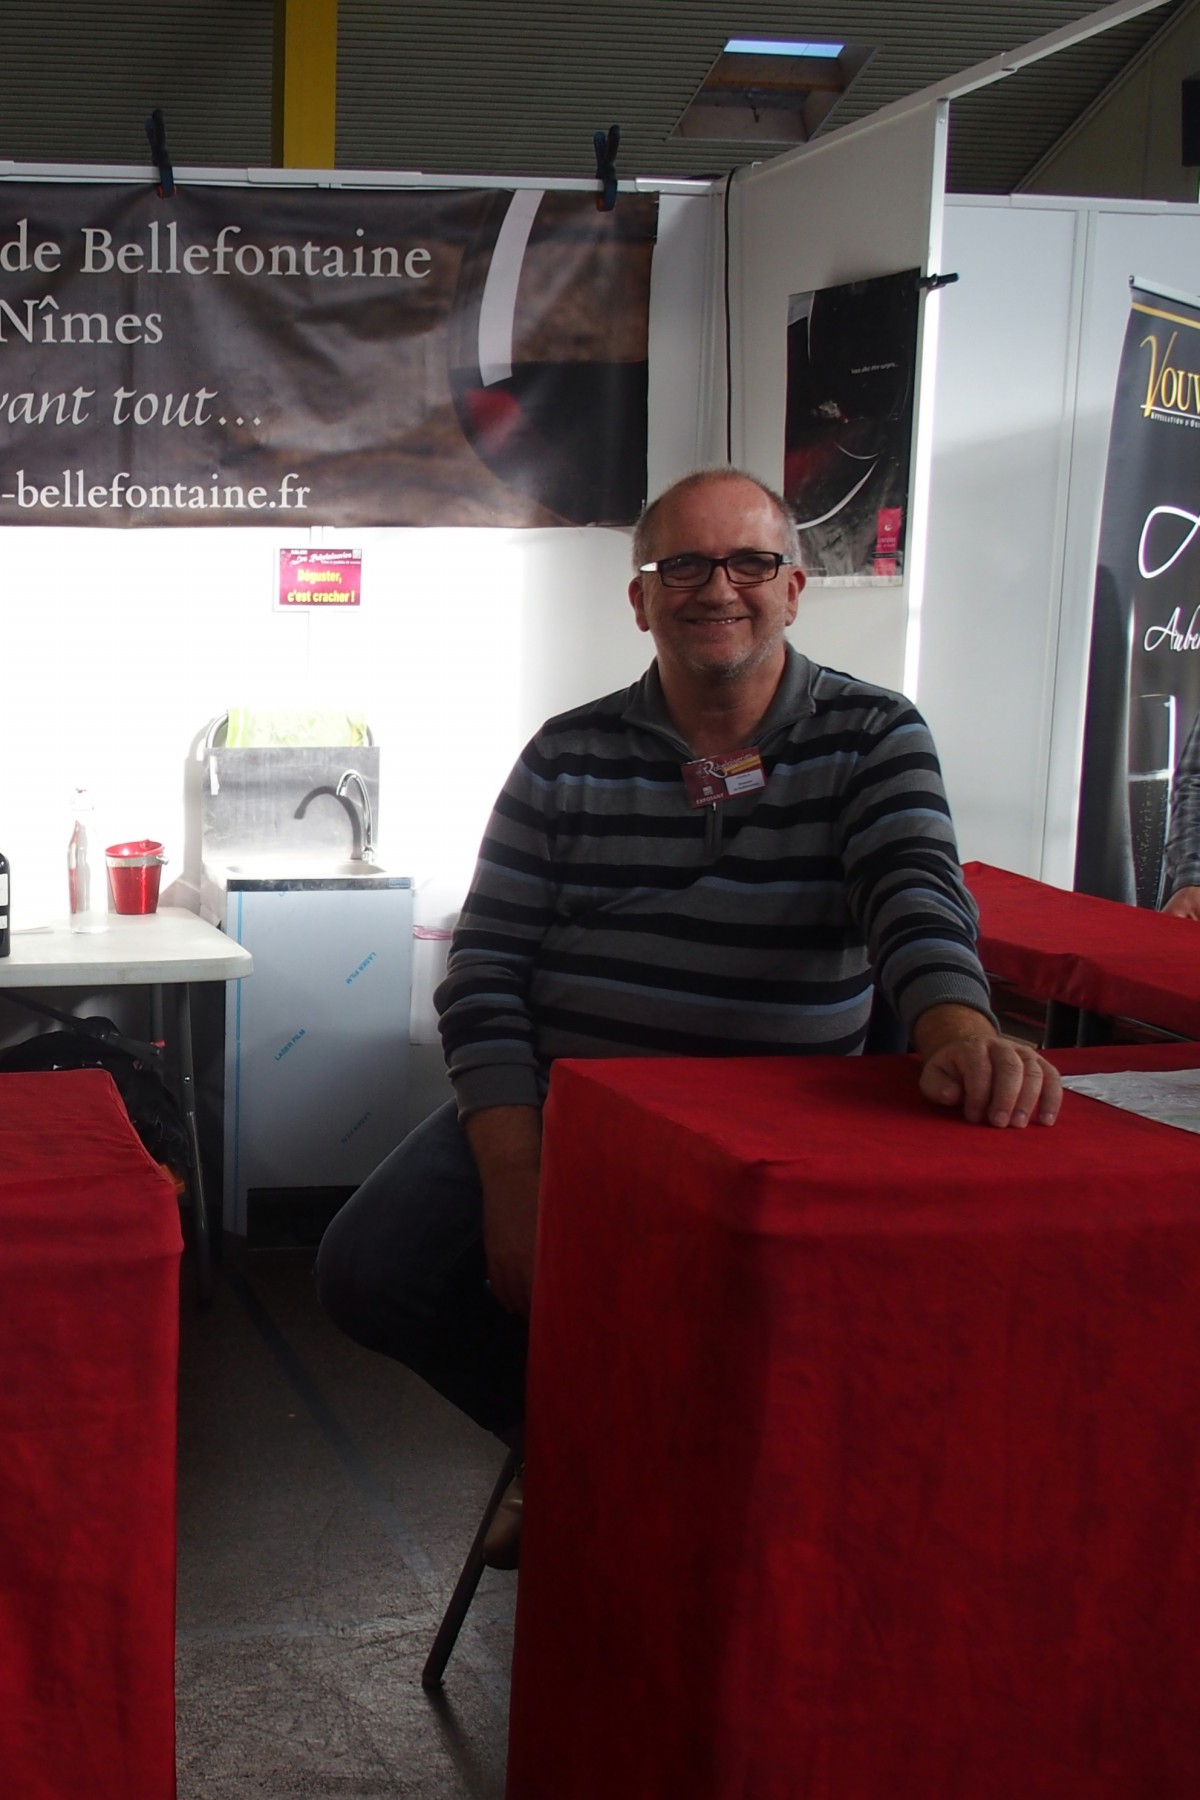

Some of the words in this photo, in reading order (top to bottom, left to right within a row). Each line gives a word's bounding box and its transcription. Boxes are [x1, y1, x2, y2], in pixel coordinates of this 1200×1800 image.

[0, 218, 61, 272] de
[80, 220, 431, 279] Bellefontaine
[298, 569, 341, 585] Déguster,
[287, 590, 311, 603] c'est
[313, 590, 349, 603] cracher
[274, 1041, 294, 1061] LASER
[291, 1029, 306, 1044] FILM
